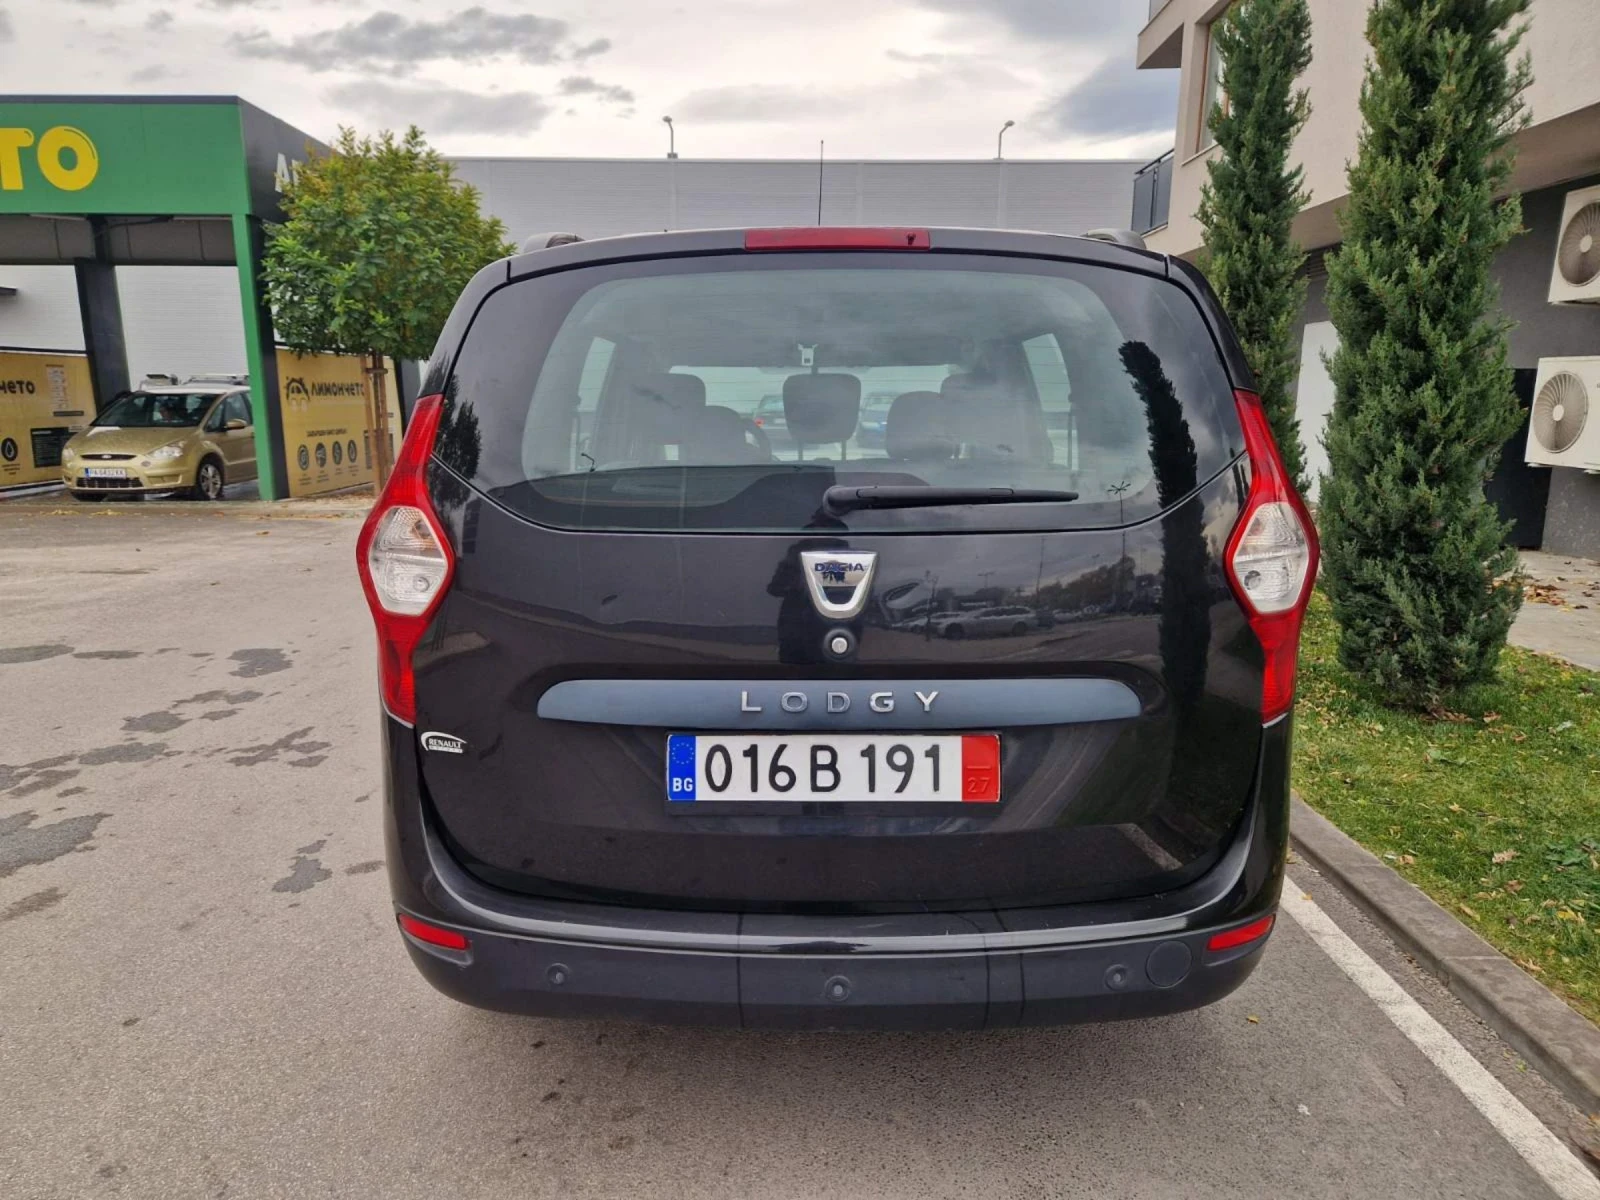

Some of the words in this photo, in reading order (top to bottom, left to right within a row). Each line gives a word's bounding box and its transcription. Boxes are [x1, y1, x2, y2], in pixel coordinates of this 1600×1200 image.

[814, 562, 865, 572] DACIA
[740, 690, 939, 713] LODGY
[428, 738, 461, 749] RENAULT
[672, 777, 694, 792] BG
[967, 777, 989, 793] 27
